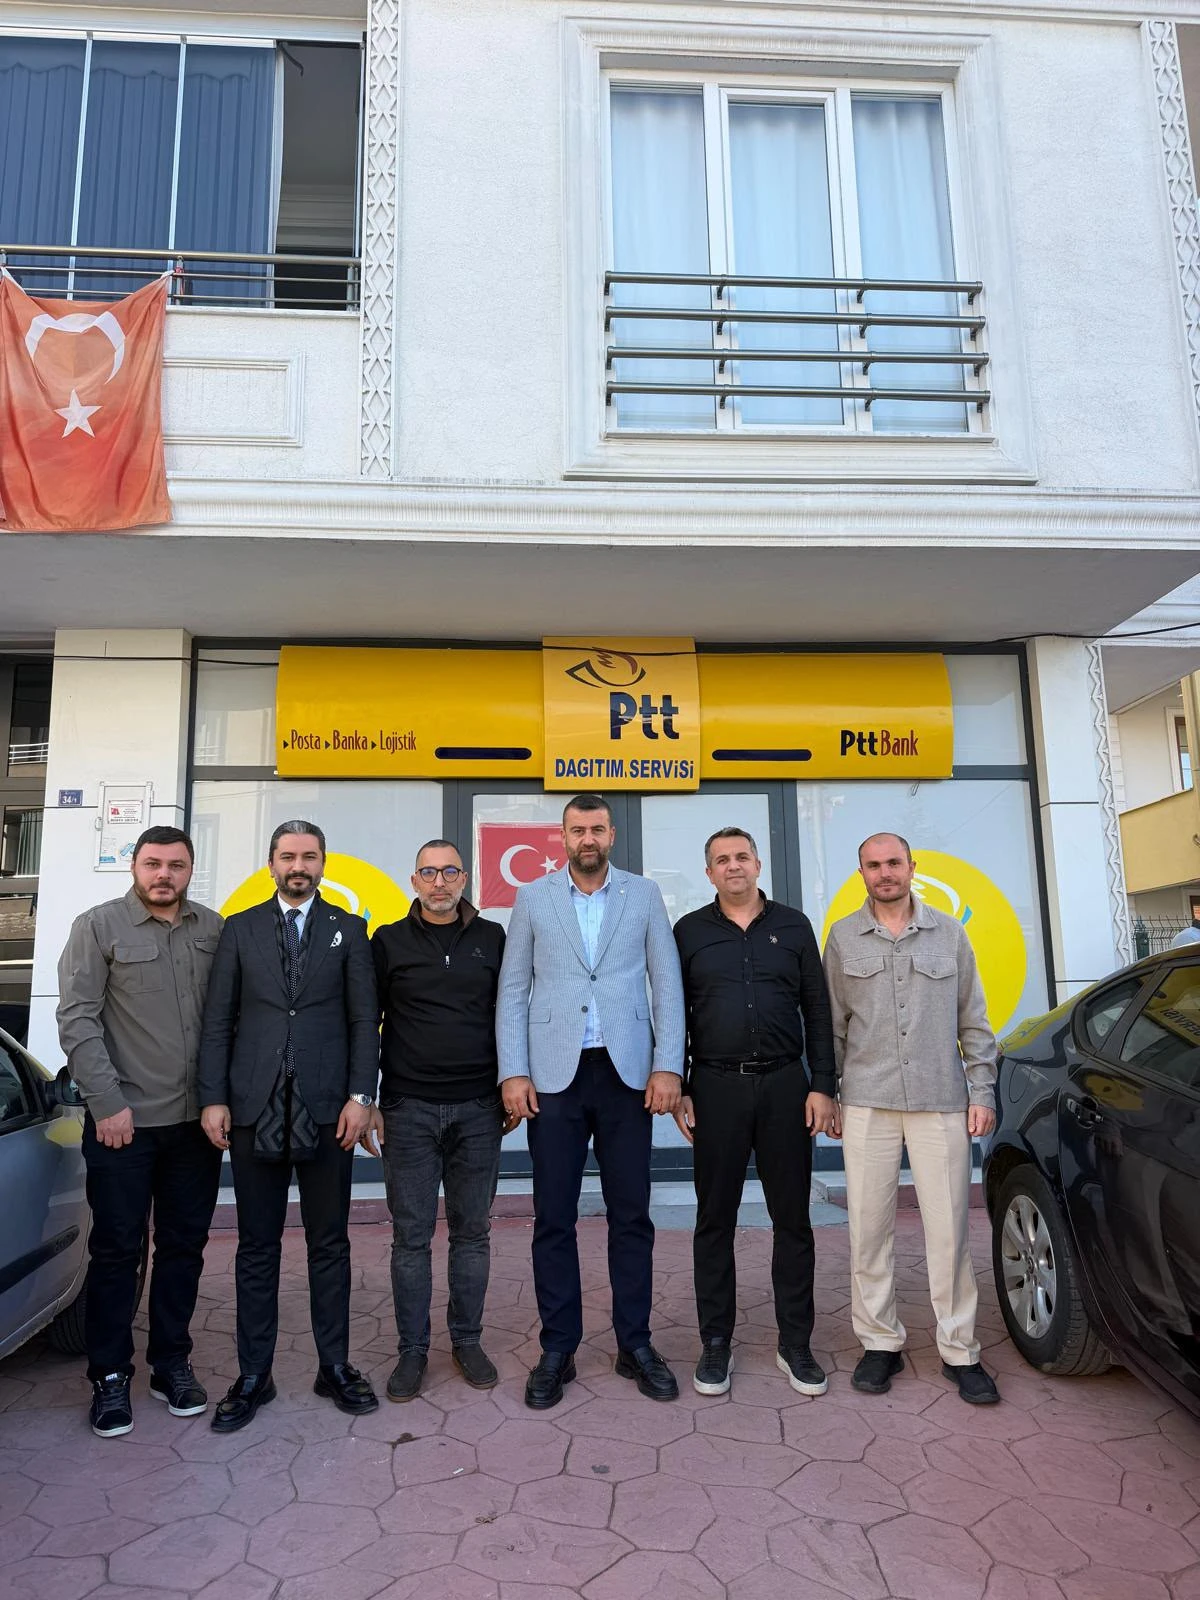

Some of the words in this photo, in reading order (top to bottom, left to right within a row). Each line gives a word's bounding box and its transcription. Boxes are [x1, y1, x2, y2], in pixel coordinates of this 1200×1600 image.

[609, 691, 680, 740] Ptt
[290, 729, 321, 750] Posta
[332, 729, 368, 751] Banka
[380, 729, 417, 755] Lojistik
